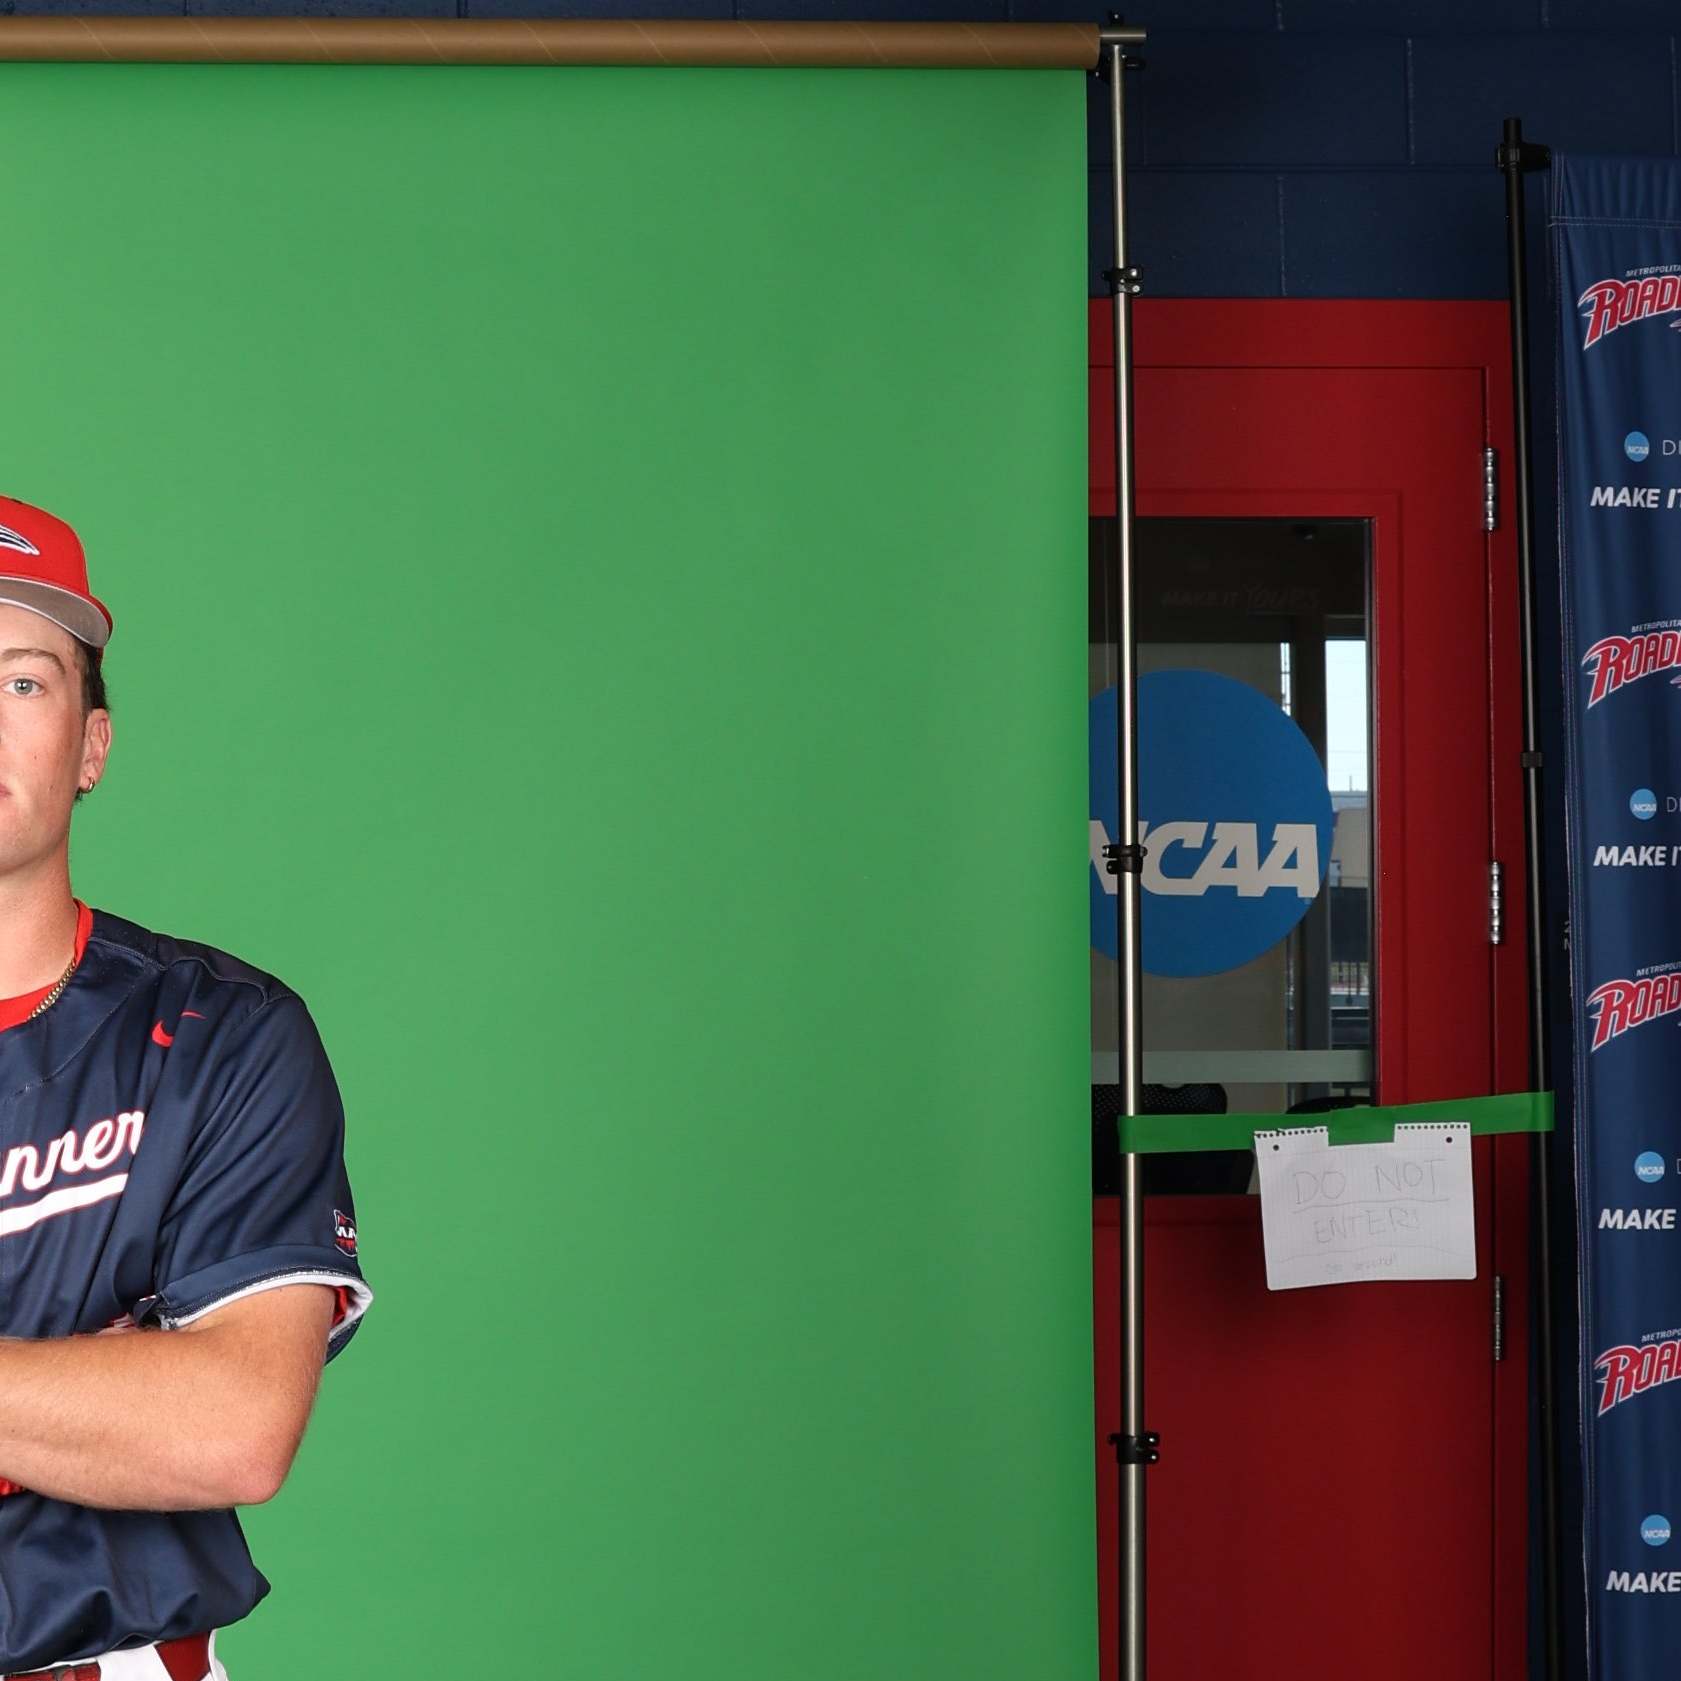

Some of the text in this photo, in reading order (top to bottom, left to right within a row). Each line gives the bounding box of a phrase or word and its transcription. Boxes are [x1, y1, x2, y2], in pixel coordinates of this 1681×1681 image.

[1577, 275, 1681, 350] ROAD
[1590, 486, 1661, 508] MAKE
[1581, 631, 1681, 709] ROAD
[1593, 845, 1667, 866] MAKE
[1293, 1159, 1446, 1204] DO NOT
[1598, 1208, 1677, 1229] MAKE
[1594, 1339, 1681, 1417] ROA
[1606, 1570, 1681, 1593] MAKE
